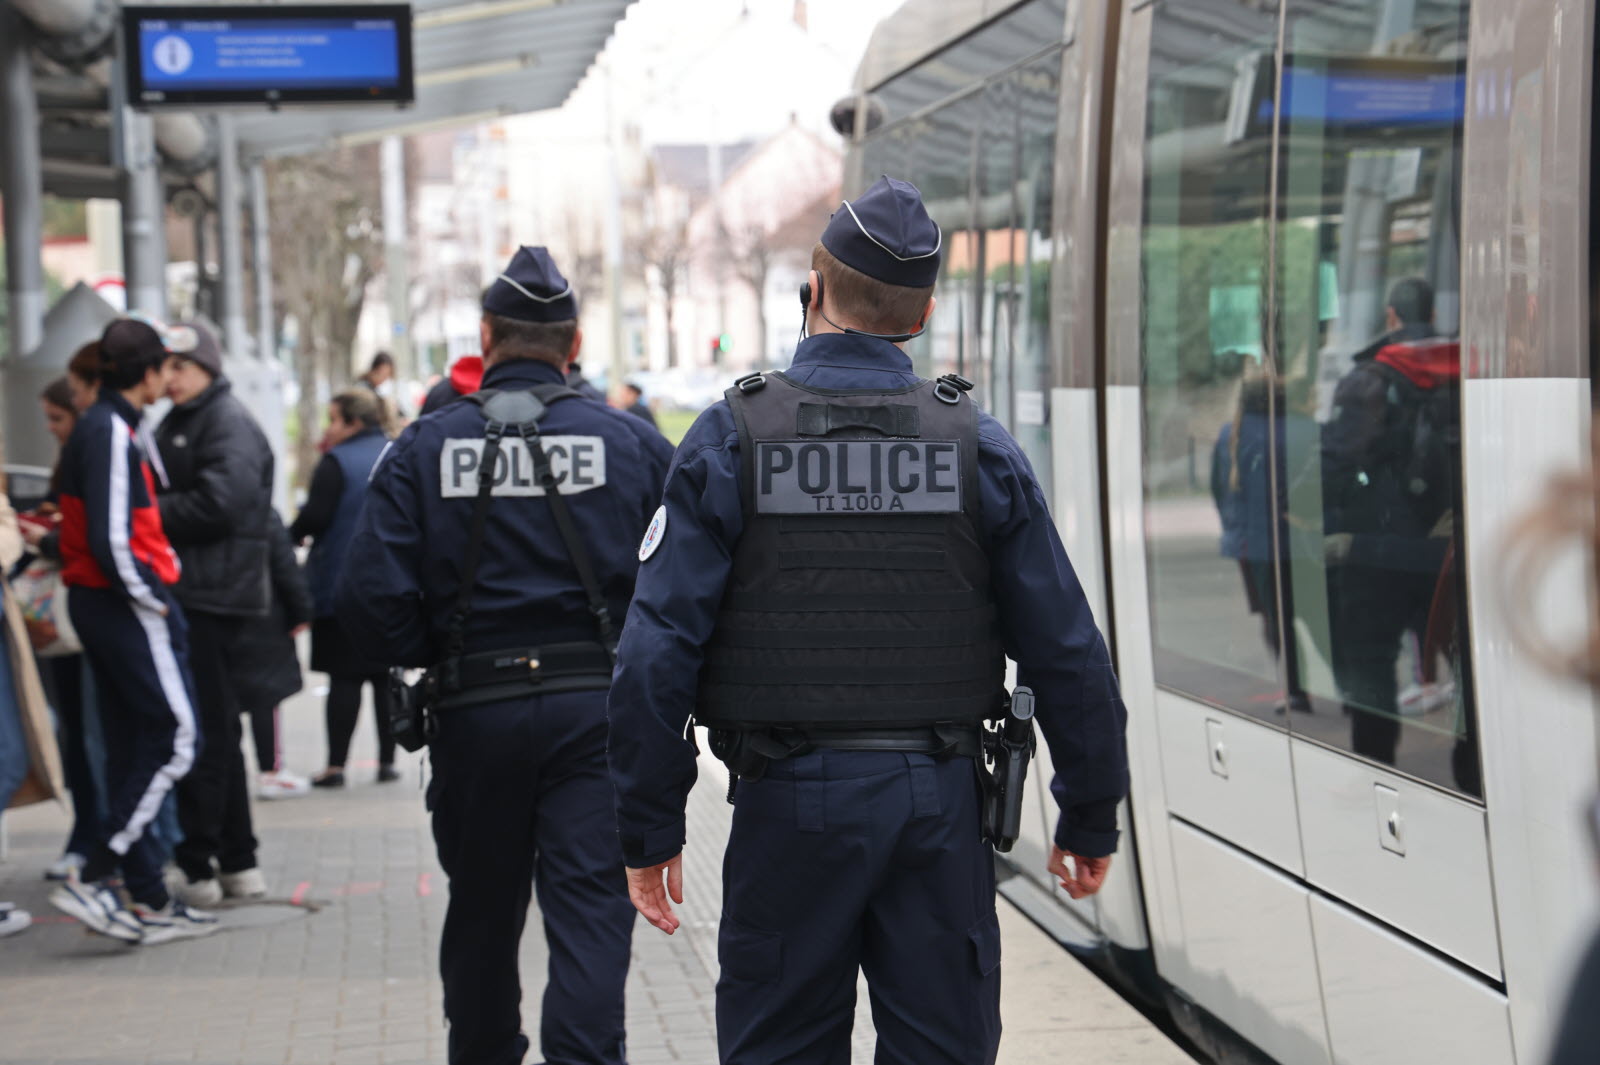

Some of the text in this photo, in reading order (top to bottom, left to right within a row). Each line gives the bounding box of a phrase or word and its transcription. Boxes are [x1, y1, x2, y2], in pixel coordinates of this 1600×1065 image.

[452, 444, 594, 488] POLCE
[761, 443, 956, 495] POLICE
[811, 494, 905, 511] TI 100 A
